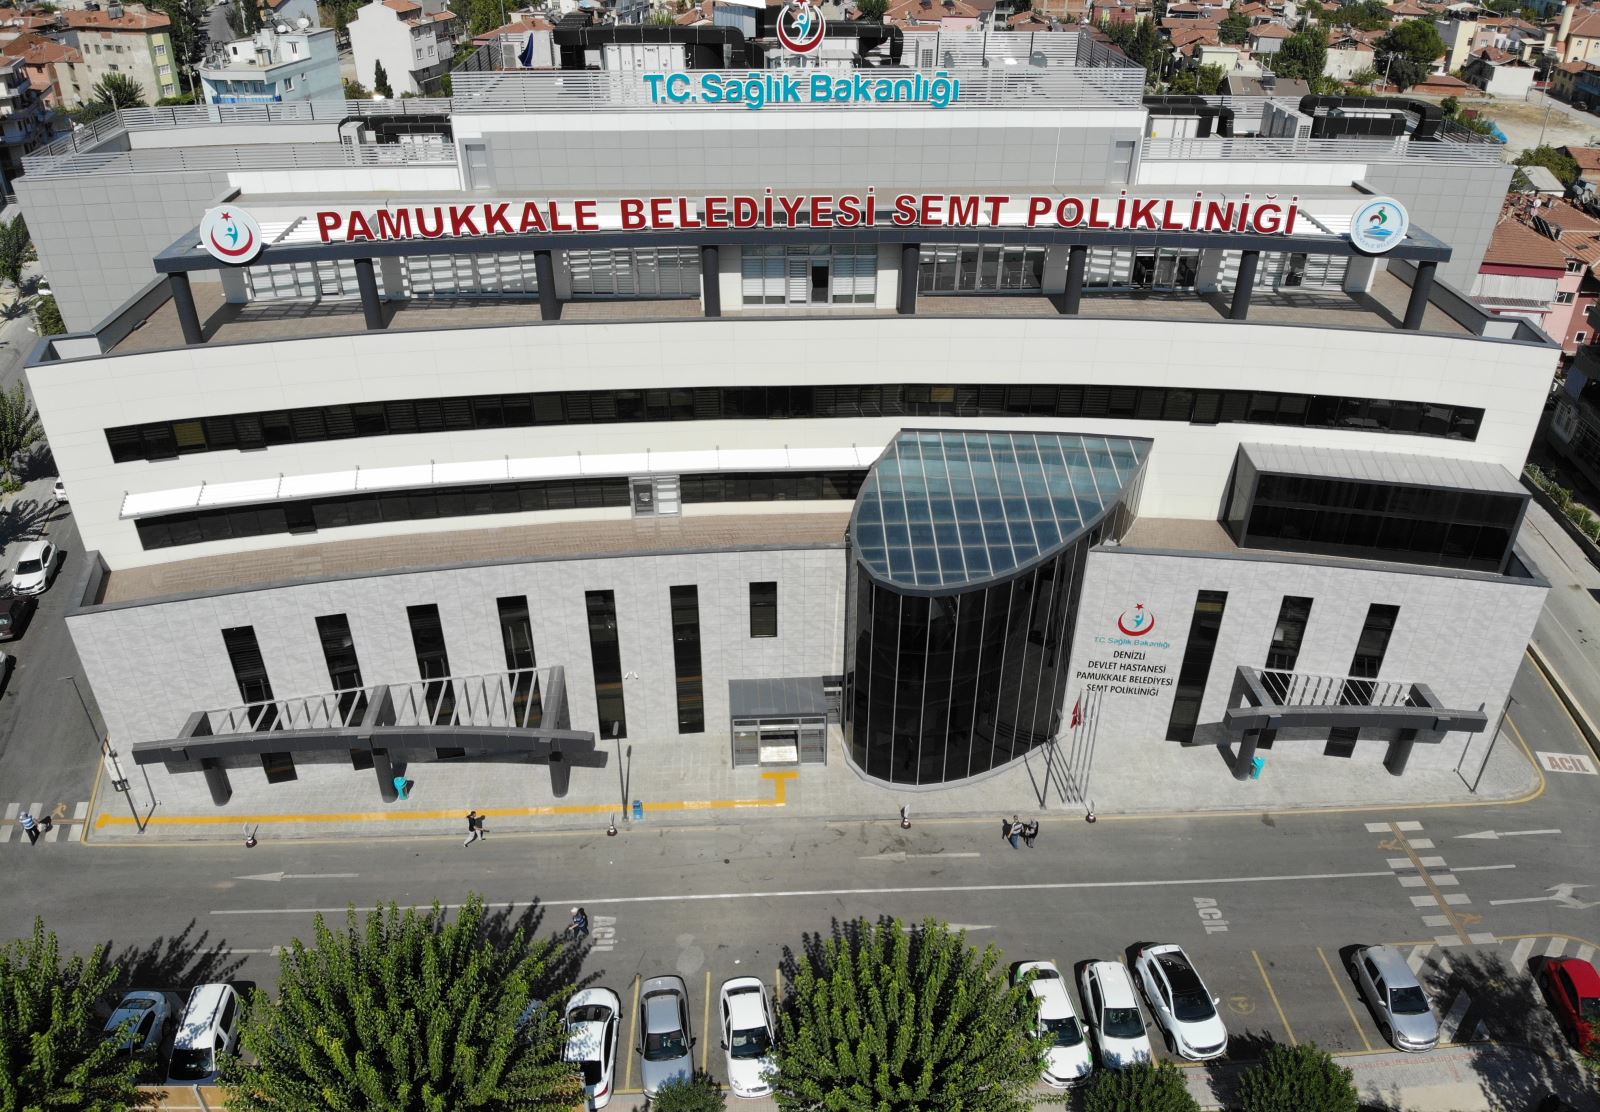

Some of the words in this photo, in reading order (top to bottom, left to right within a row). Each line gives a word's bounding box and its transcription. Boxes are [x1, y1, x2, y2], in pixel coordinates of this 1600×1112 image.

[642, 73, 697, 104] T.C.
[700, 72, 802, 110] Sağlık
[810, 71, 960, 109] Bakanlığı
[316, 199, 600, 244] PAMUKKALE
[619, 186, 876, 230] BELEDİYESİ
[892, 194, 1010, 227] SEMT
[1026, 189, 1299, 236] POLİKLİNİĞİ
[1113, 650, 1146, 660] DENİZLİ
[1088, 660, 1118, 670] DEVLET
[1120, 663, 1167, 673] HASTANESİ
[1076, 671, 1127, 682] PAMUKKALE
[1129, 675, 1174, 686] BELEDİYESİ
[1086, 683, 1109, 693] SEMT
[1110, 685, 1159, 696] POLİKLİNİĞİ
[1193, 896, 1229, 935] ACİL
